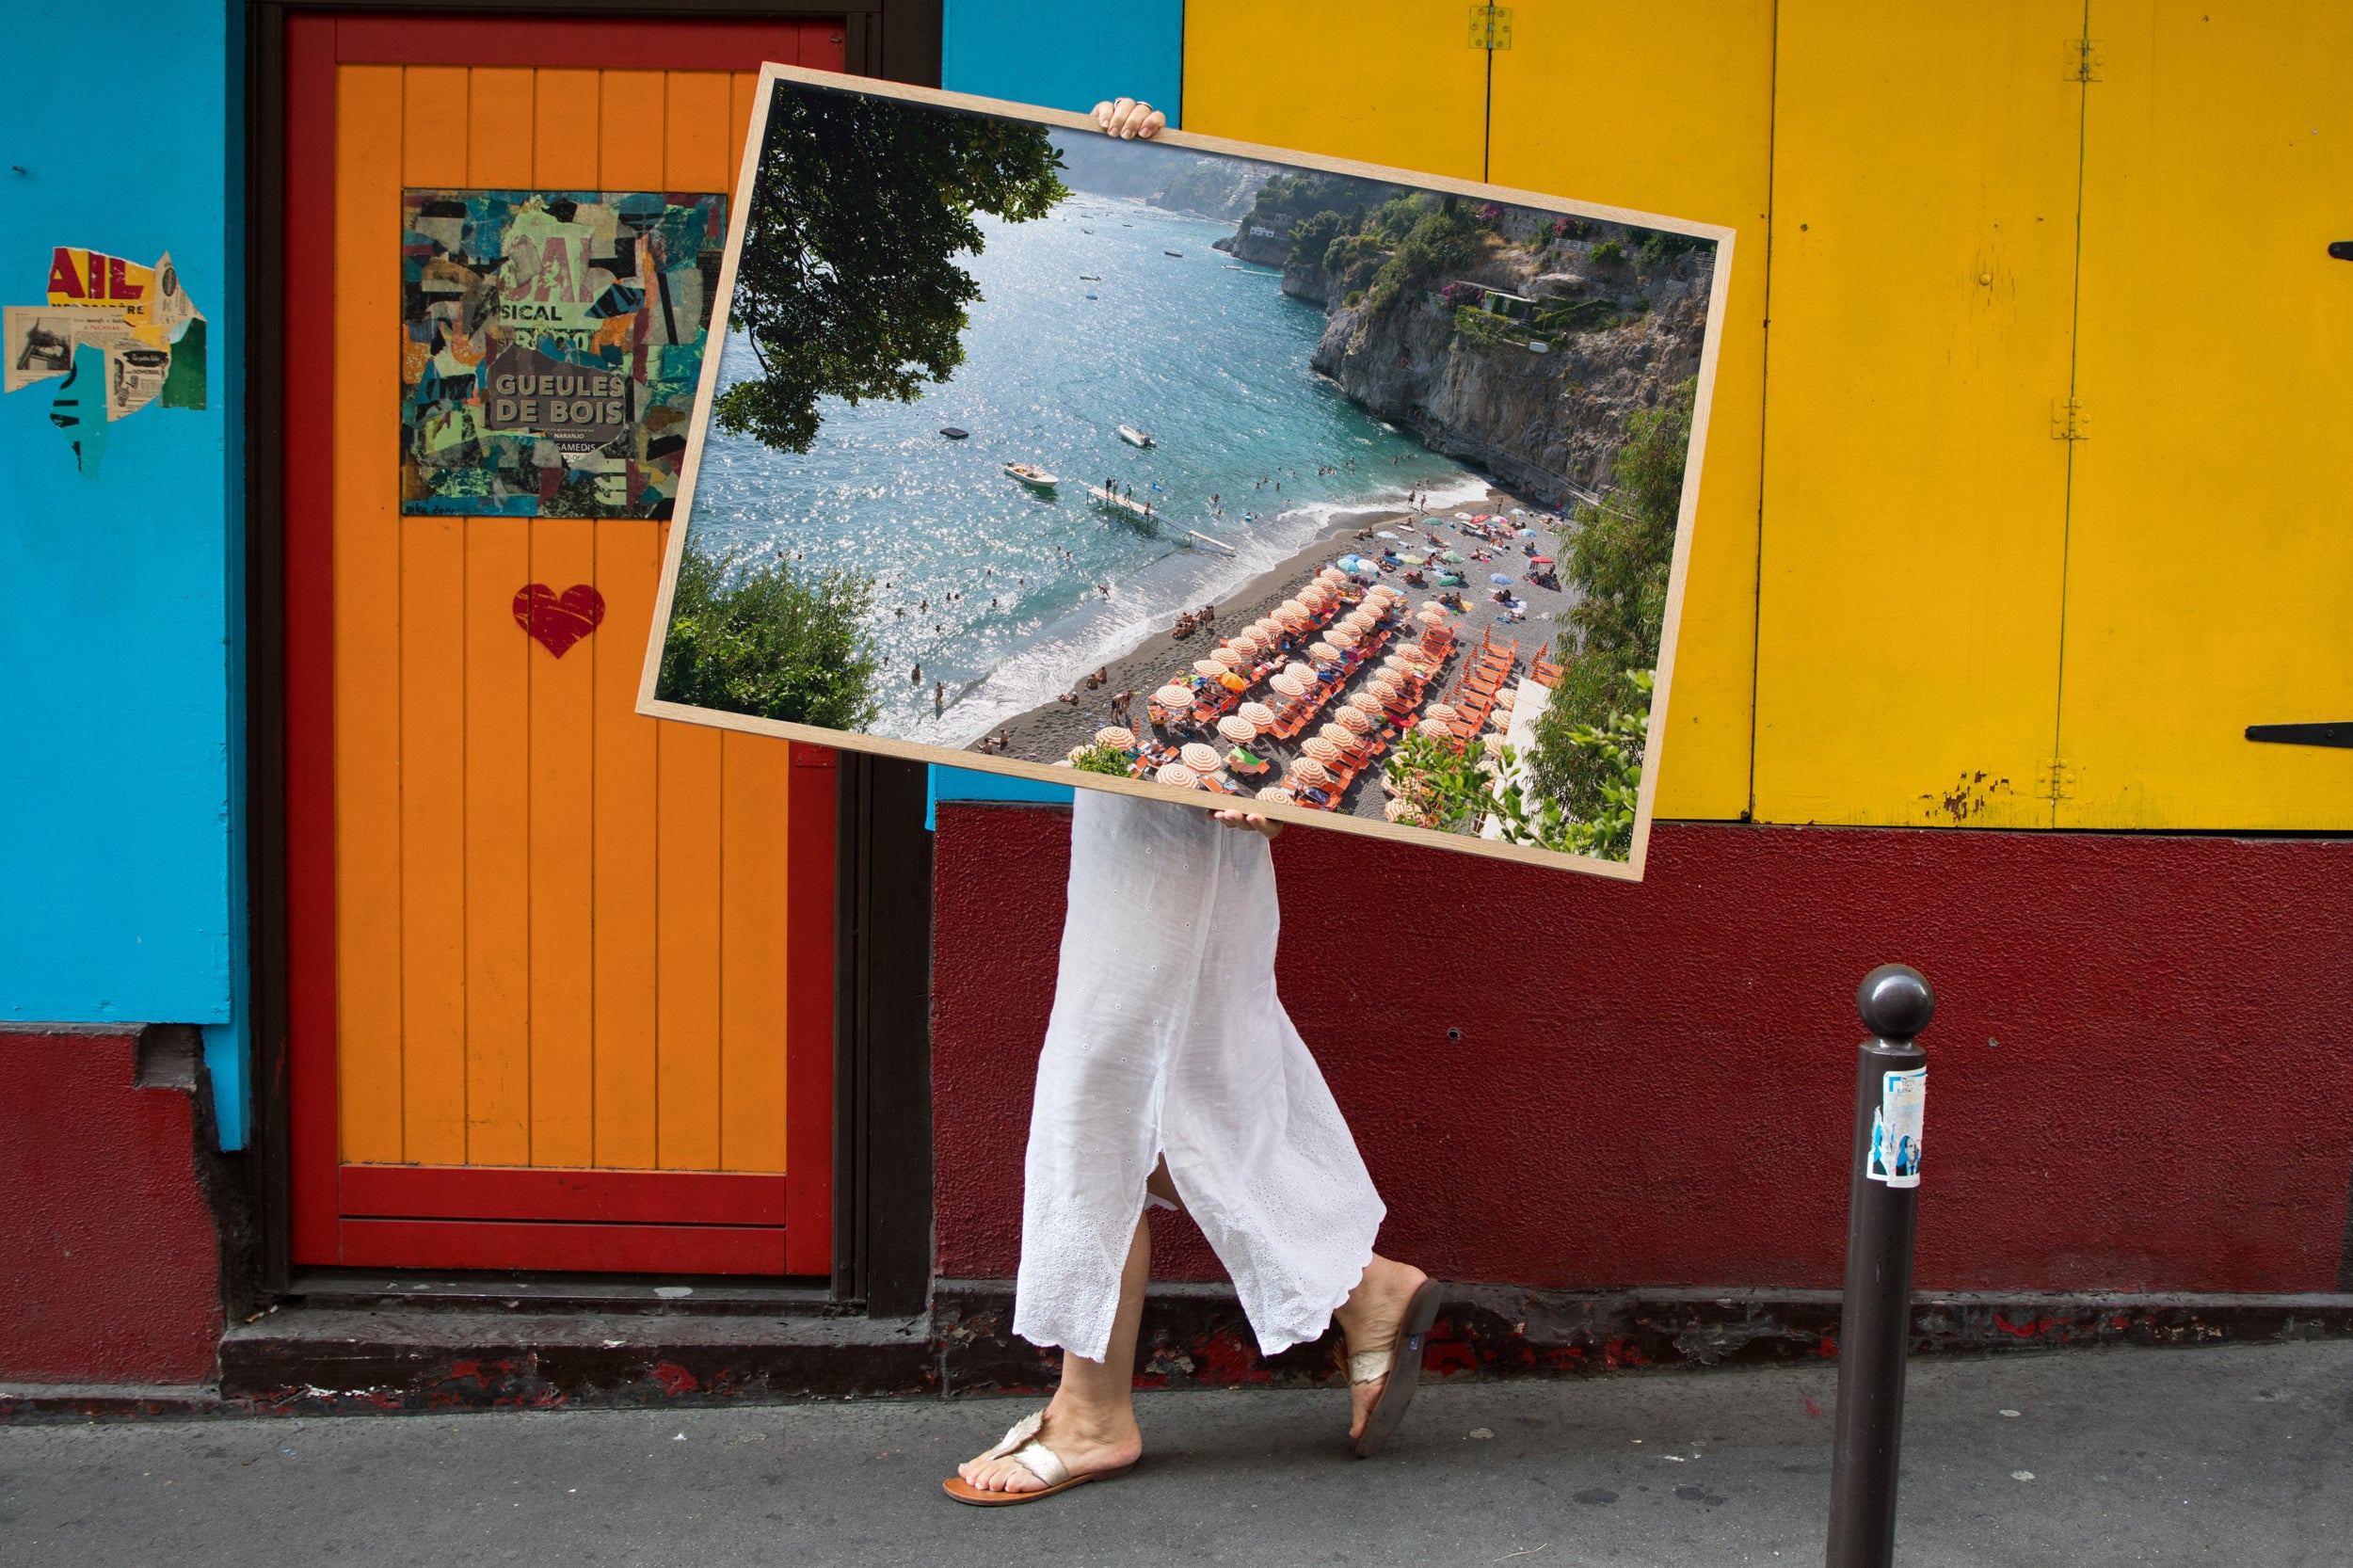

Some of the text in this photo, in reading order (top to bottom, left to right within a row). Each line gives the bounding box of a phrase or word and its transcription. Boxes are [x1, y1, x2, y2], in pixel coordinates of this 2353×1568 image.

[501, 305, 562, 321] SICAL
[496, 375, 623, 397] GUEULES
[496, 399, 622, 424] DE BOIS
[555, 443, 596, 452] SAMEDIS
